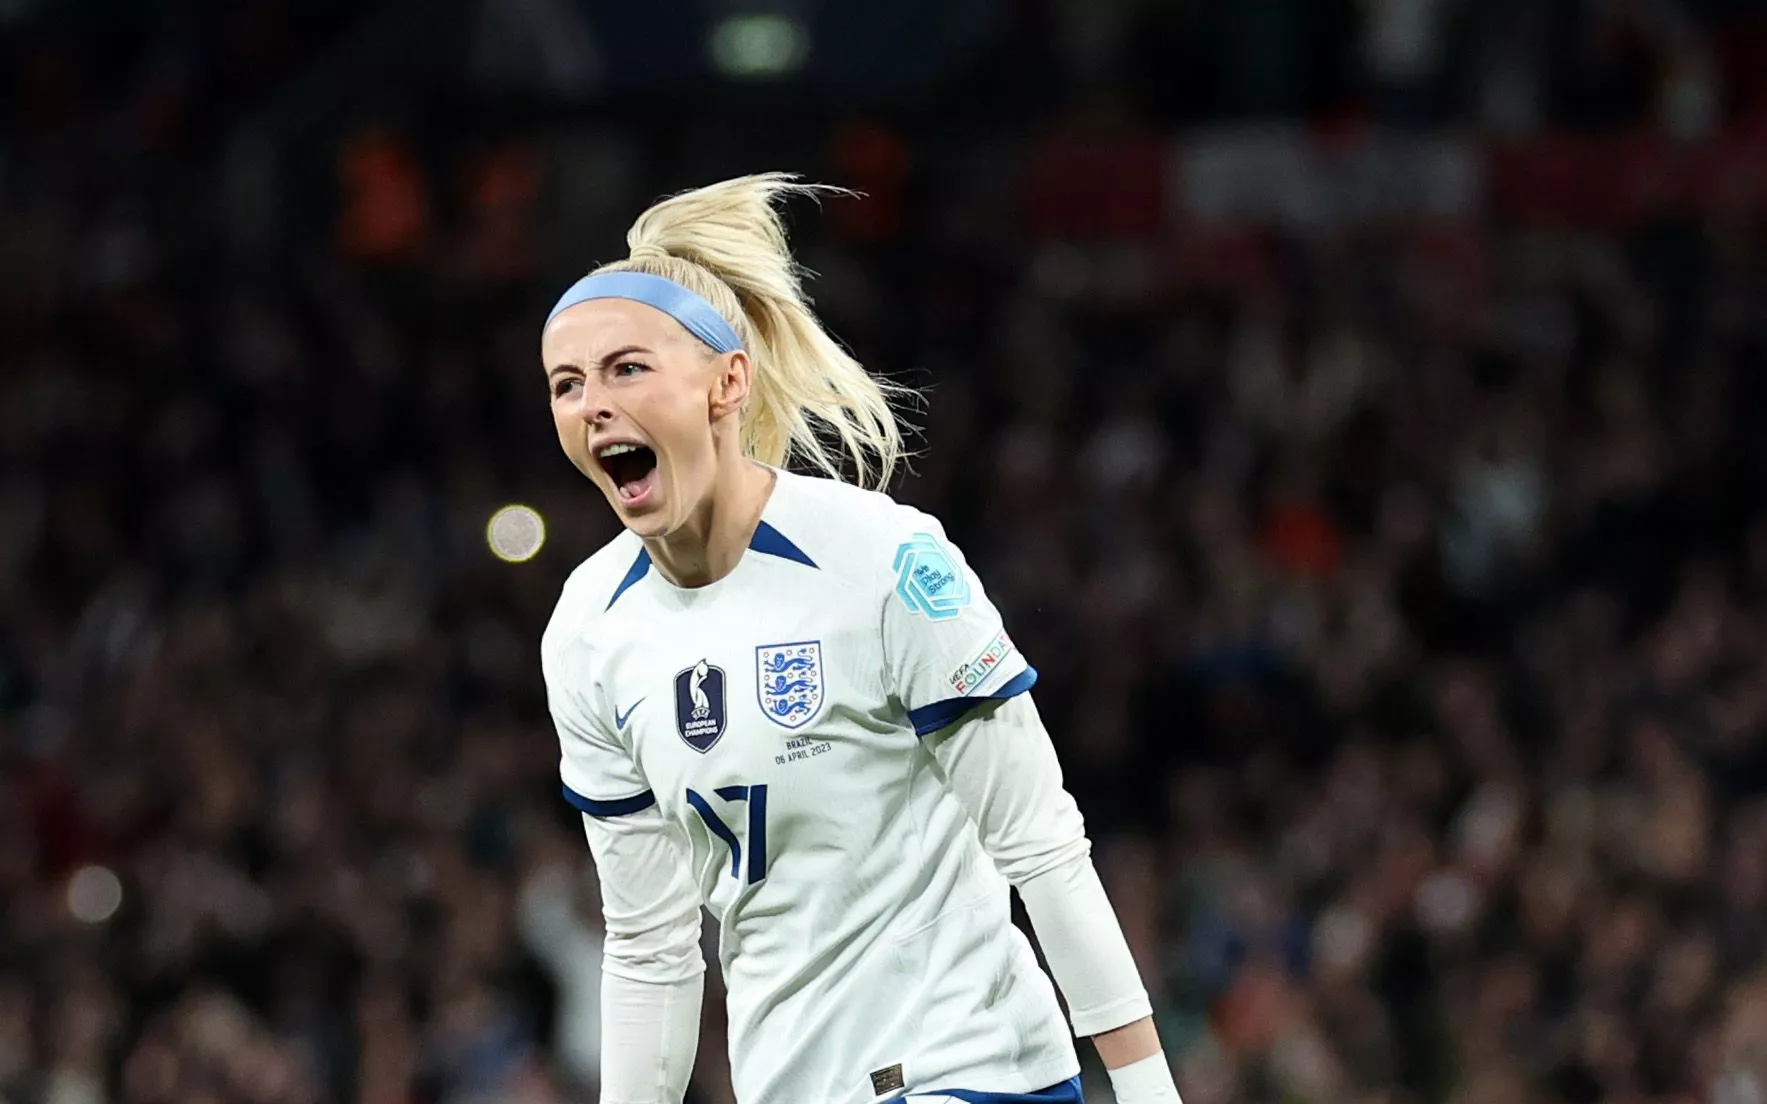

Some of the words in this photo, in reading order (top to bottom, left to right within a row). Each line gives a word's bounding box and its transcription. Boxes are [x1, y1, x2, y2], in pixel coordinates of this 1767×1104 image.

[949, 663, 970, 685] UEFA
[684, 726, 719, 738] CHAMPIONS
[685, 718, 717, 730] EUROPEAN
[786, 735, 813, 750] BRAZIL
[775, 754, 786, 765] 06
[788, 749, 809, 762] APRIL
[811, 741, 832, 756] 2023
[686, 784, 767, 885] 17
